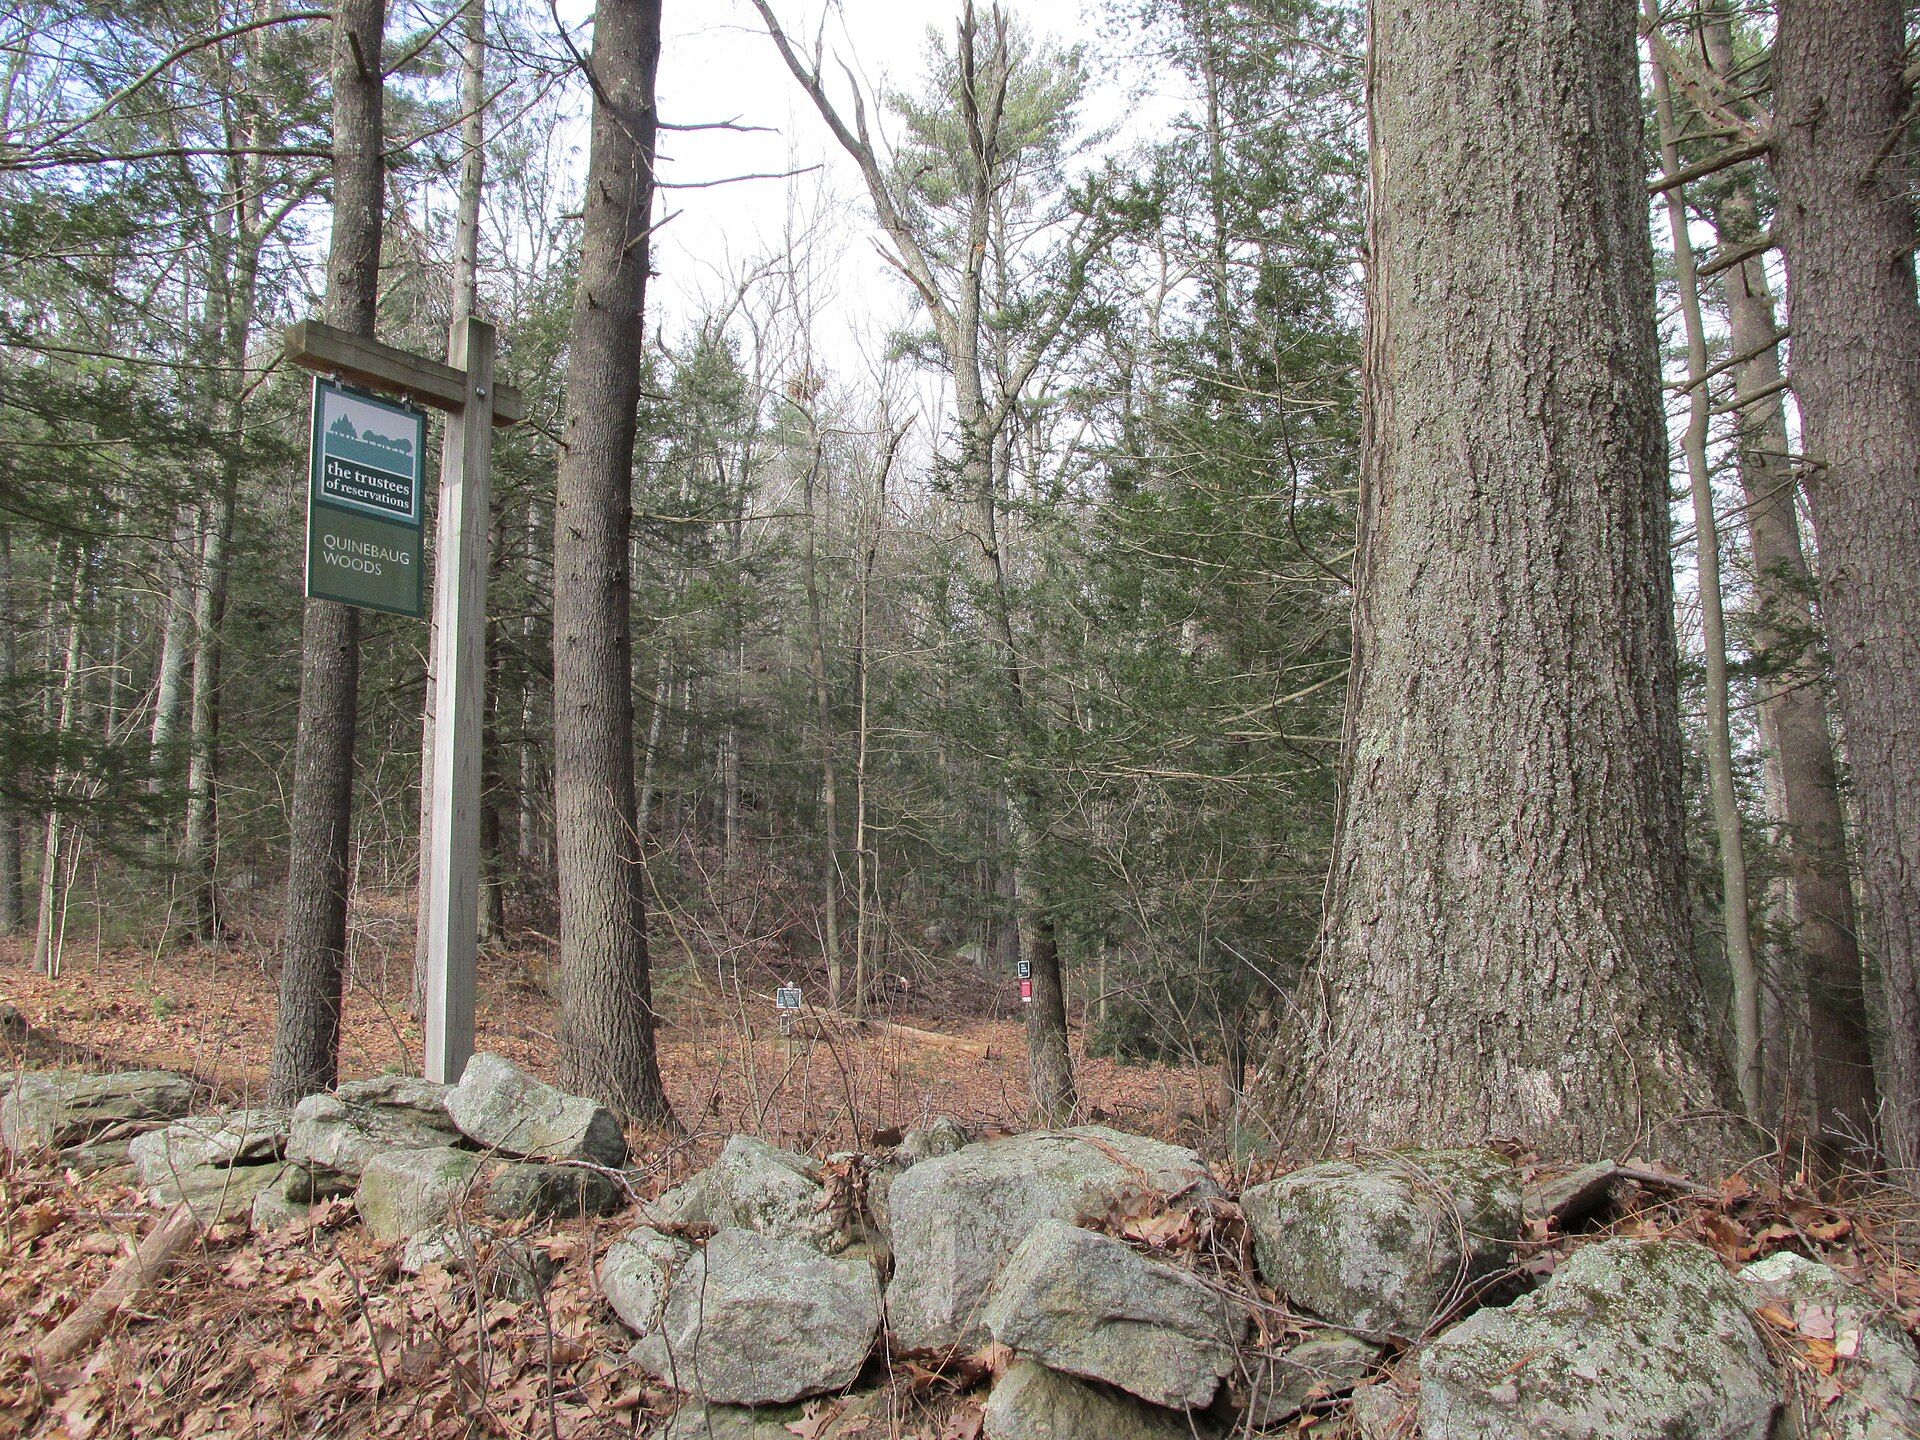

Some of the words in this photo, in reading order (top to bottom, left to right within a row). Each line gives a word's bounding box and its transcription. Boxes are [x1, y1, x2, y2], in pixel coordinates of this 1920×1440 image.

[326, 478, 341, 489] of
[341, 483, 409, 508] reservations
[327, 461, 351, 479] the
[354, 470, 410, 495] trustees
[323, 534, 410, 565] QUINEBAUG
[323, 550, 382, 575] WOODS
